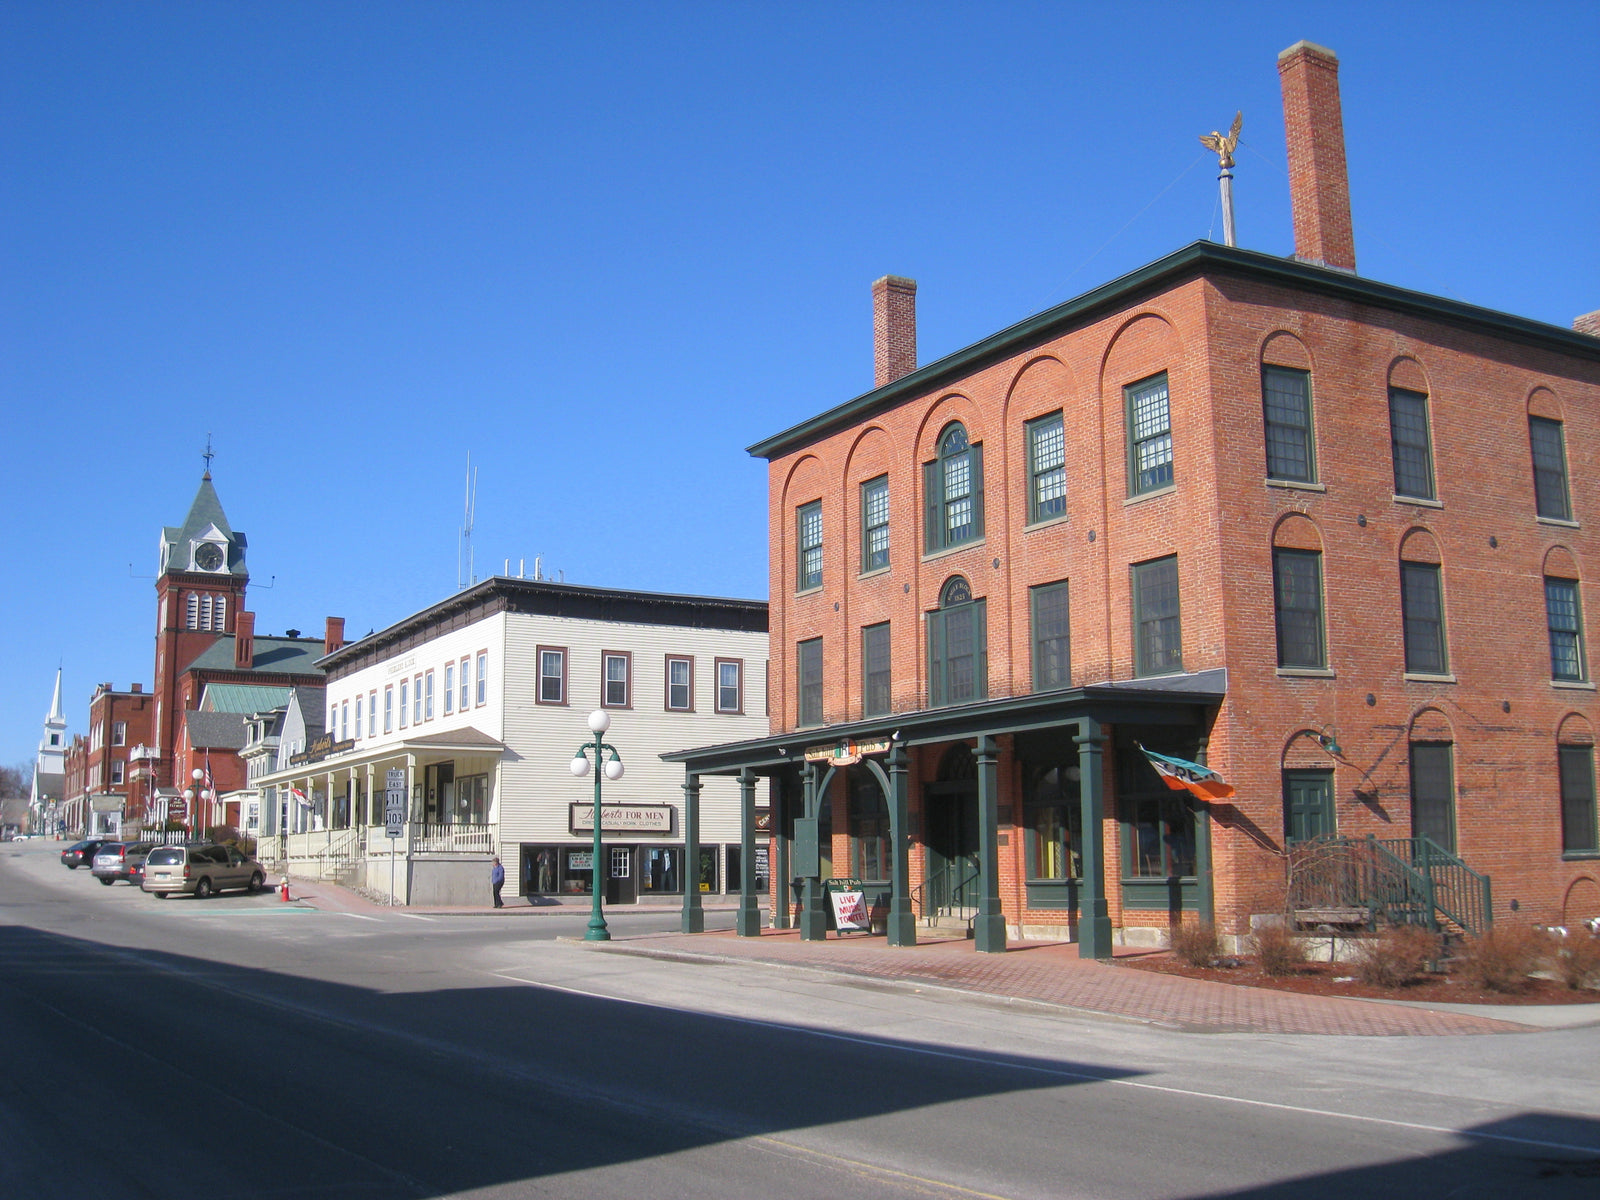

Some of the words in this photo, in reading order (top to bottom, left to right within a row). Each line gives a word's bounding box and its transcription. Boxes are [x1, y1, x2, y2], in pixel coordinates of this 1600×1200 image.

[861, 741, 876, 752] Pub
[392, 794, 399, 805] 11
[389, 813, 402, 824] 103
[626, 811, 642, 819] FOR
[645, 812, 664, 820] MEN
[840, 895, 856, 904] LIVE
[839, 904, 861, 914] MUSIC
[839, 912, 865, 924] TONITE!
